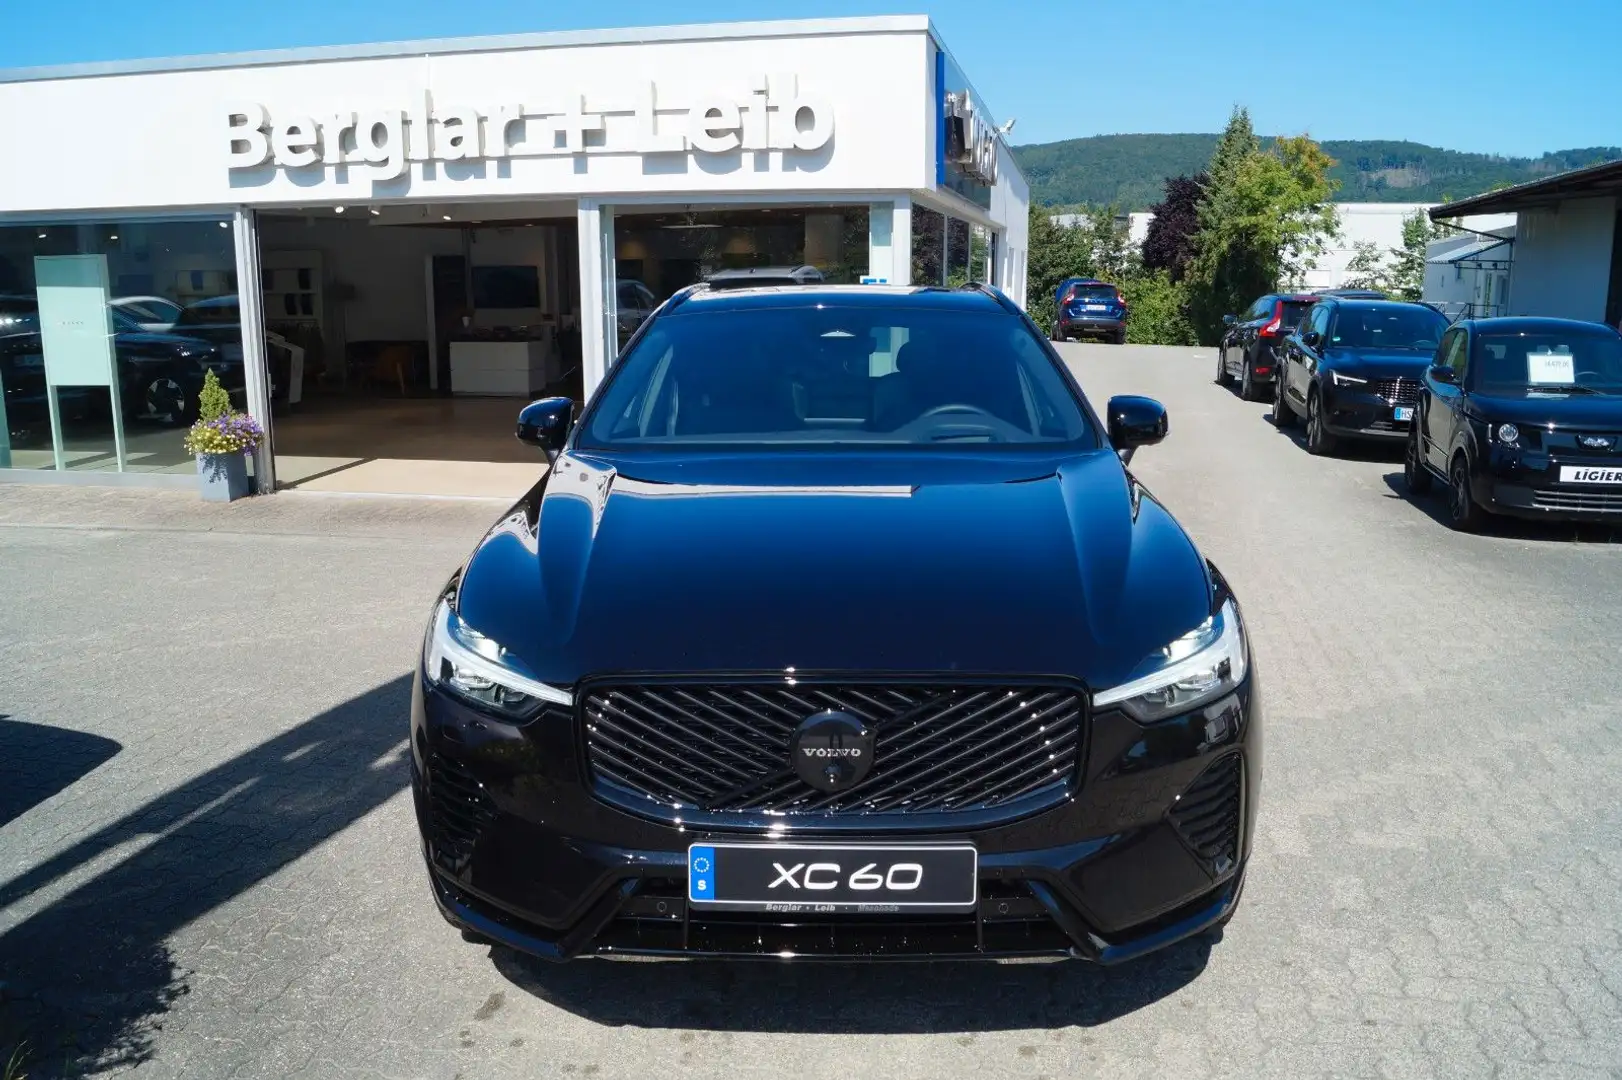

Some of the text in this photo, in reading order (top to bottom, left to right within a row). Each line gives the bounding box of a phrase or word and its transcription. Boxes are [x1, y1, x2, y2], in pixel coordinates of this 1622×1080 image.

[217, 88, 523, 182] Berglar
[636, 72, 835, 153] Leib
[802, 747, 861, 757] VOLVO
[768, 862, 923, 890] XC 60
[697, 879, 707, 891] S
[765, 902, 802, 912] Berglar
[814, 903, 836, 912] Leib
